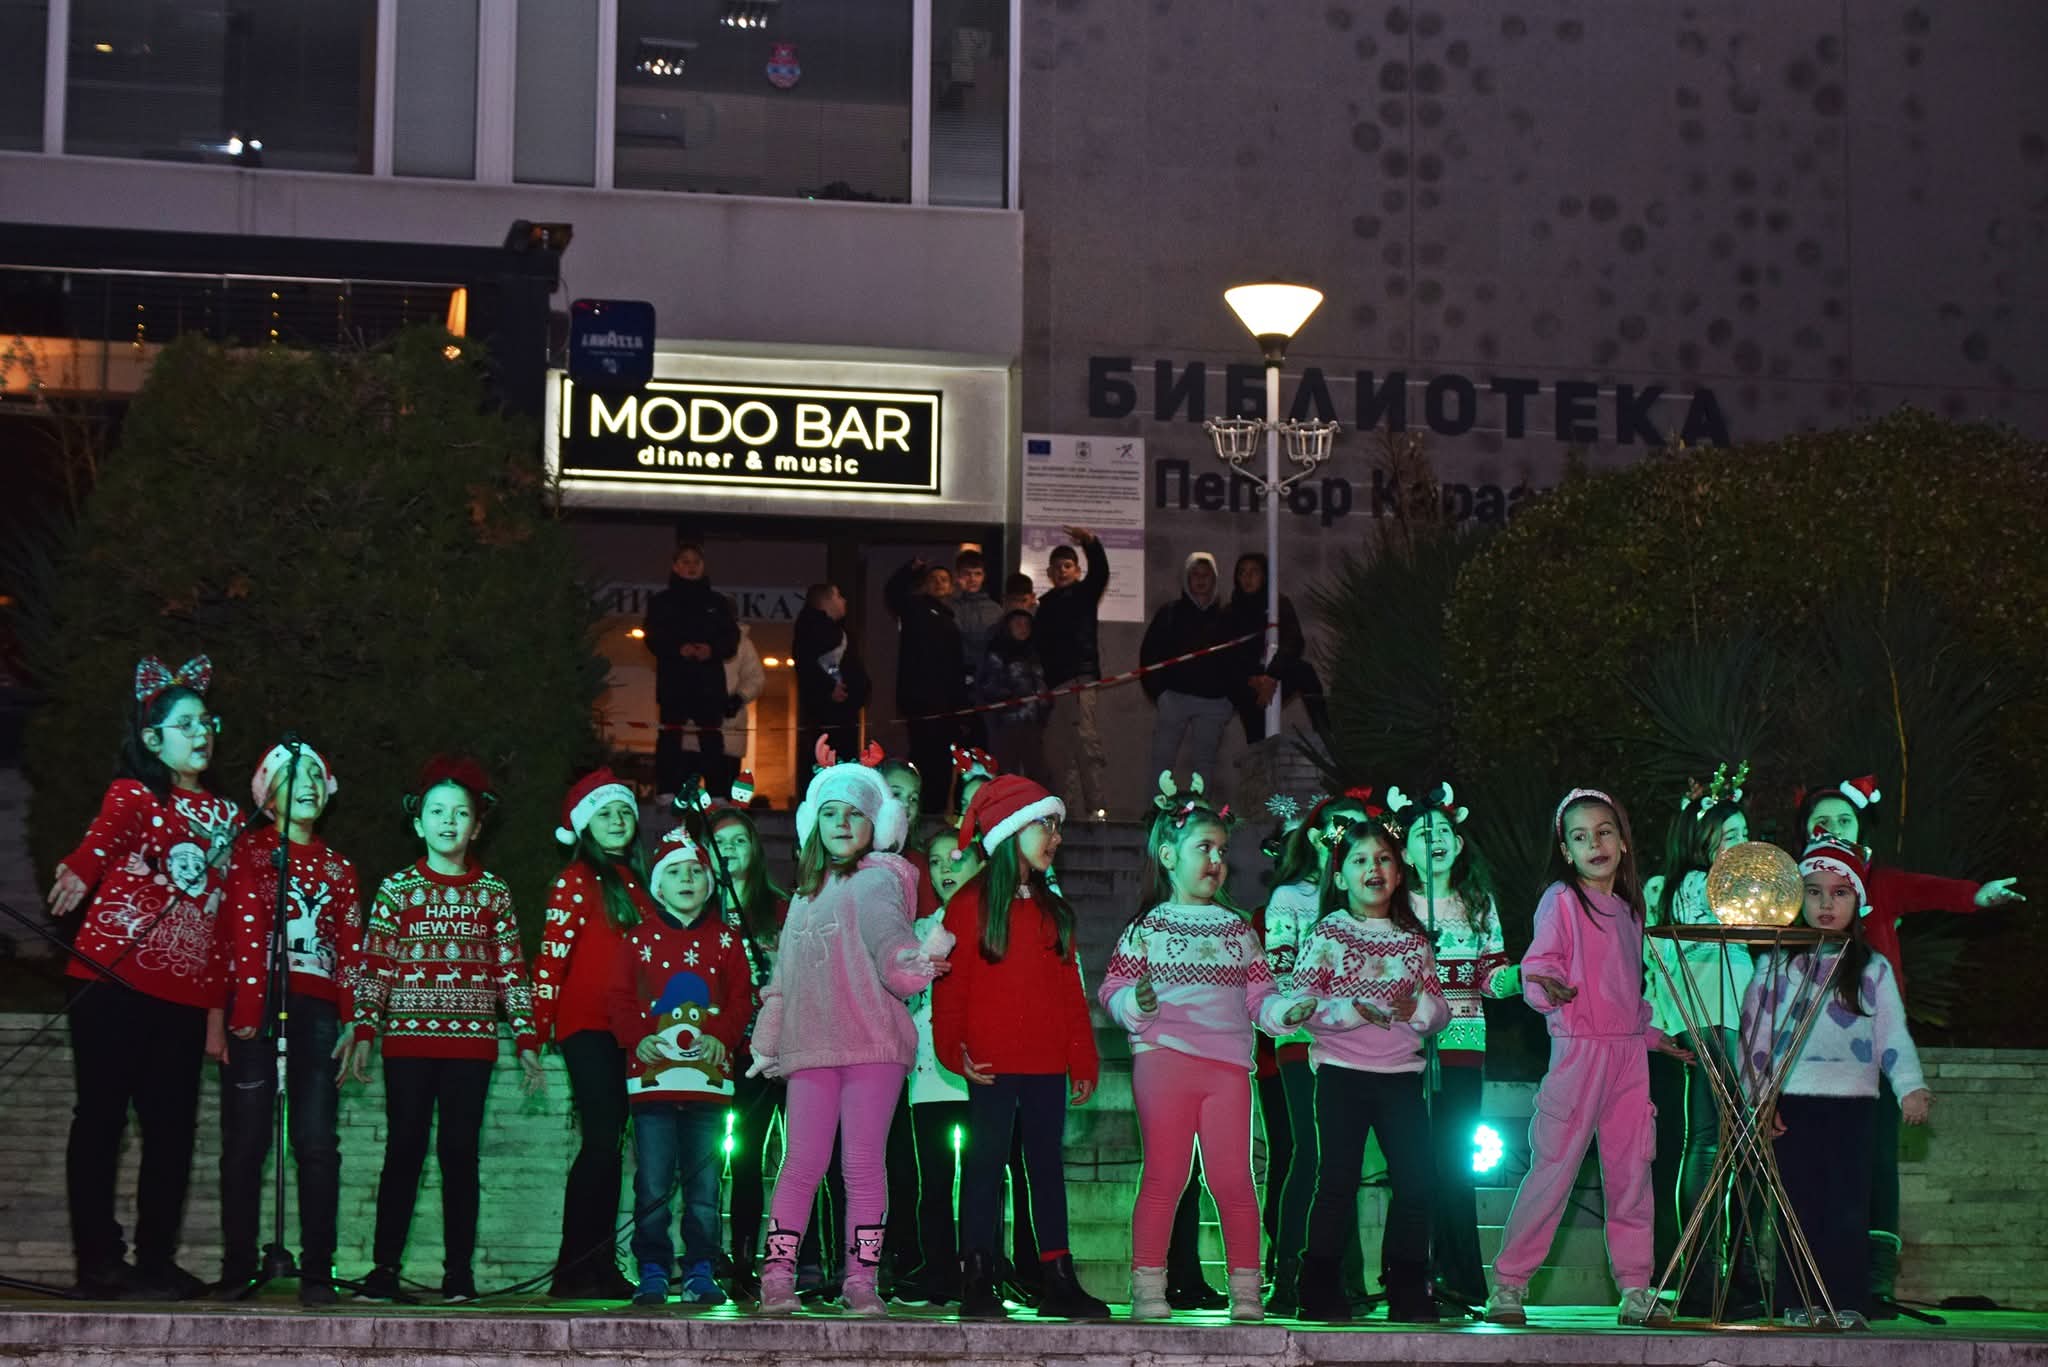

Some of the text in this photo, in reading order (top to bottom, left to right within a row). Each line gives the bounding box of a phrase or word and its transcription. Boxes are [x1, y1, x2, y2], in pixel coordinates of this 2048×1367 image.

[1088, 356, 1732, 449] БИБЛИОТЕКА
[590, 393, 911, 452] MODO BAR
[637, 445, 860, 475] dinner & music
[425, 904, 482, 920] HAPPY
[409, 921, 488, 937] NEW YEAR
